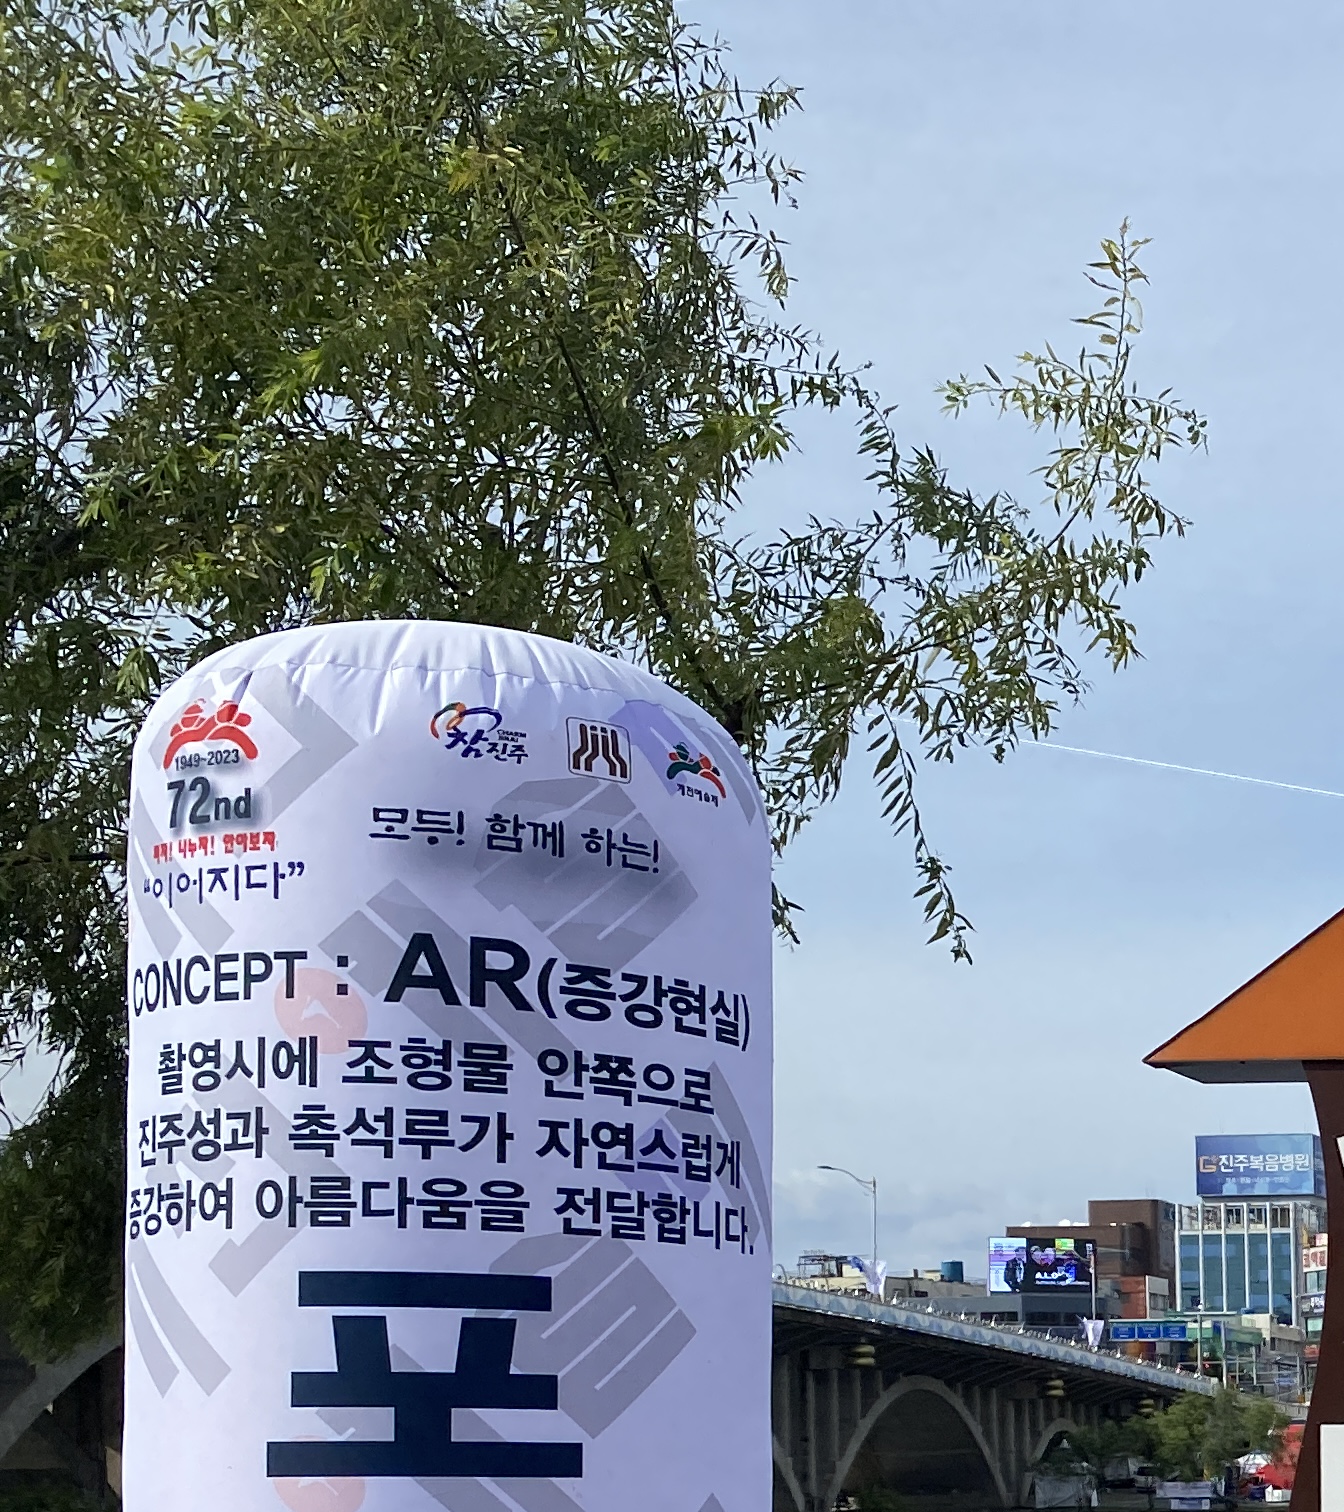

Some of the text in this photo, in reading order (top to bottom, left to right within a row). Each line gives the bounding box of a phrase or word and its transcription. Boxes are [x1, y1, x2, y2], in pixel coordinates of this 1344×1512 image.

[167, 776, 252, 828] 72nd
[368, 807, 660, 874] 모두! 함께 하는!
[134, 951, 307, 1016] CONCEPT
[384, 933, 749, 1051] AR(증강현실)
[159, 1036, 714, 1115] 촬영시에 조형물 안쪽으로
[139, 1105, 740, 1189] 진주성과 촉석루가 자연스럽게
[1219, 1153, 1310, 1173] 진주복음병원
[130, 1176, 753, 1255] 증강하여 아름다움을 전달합니다.
